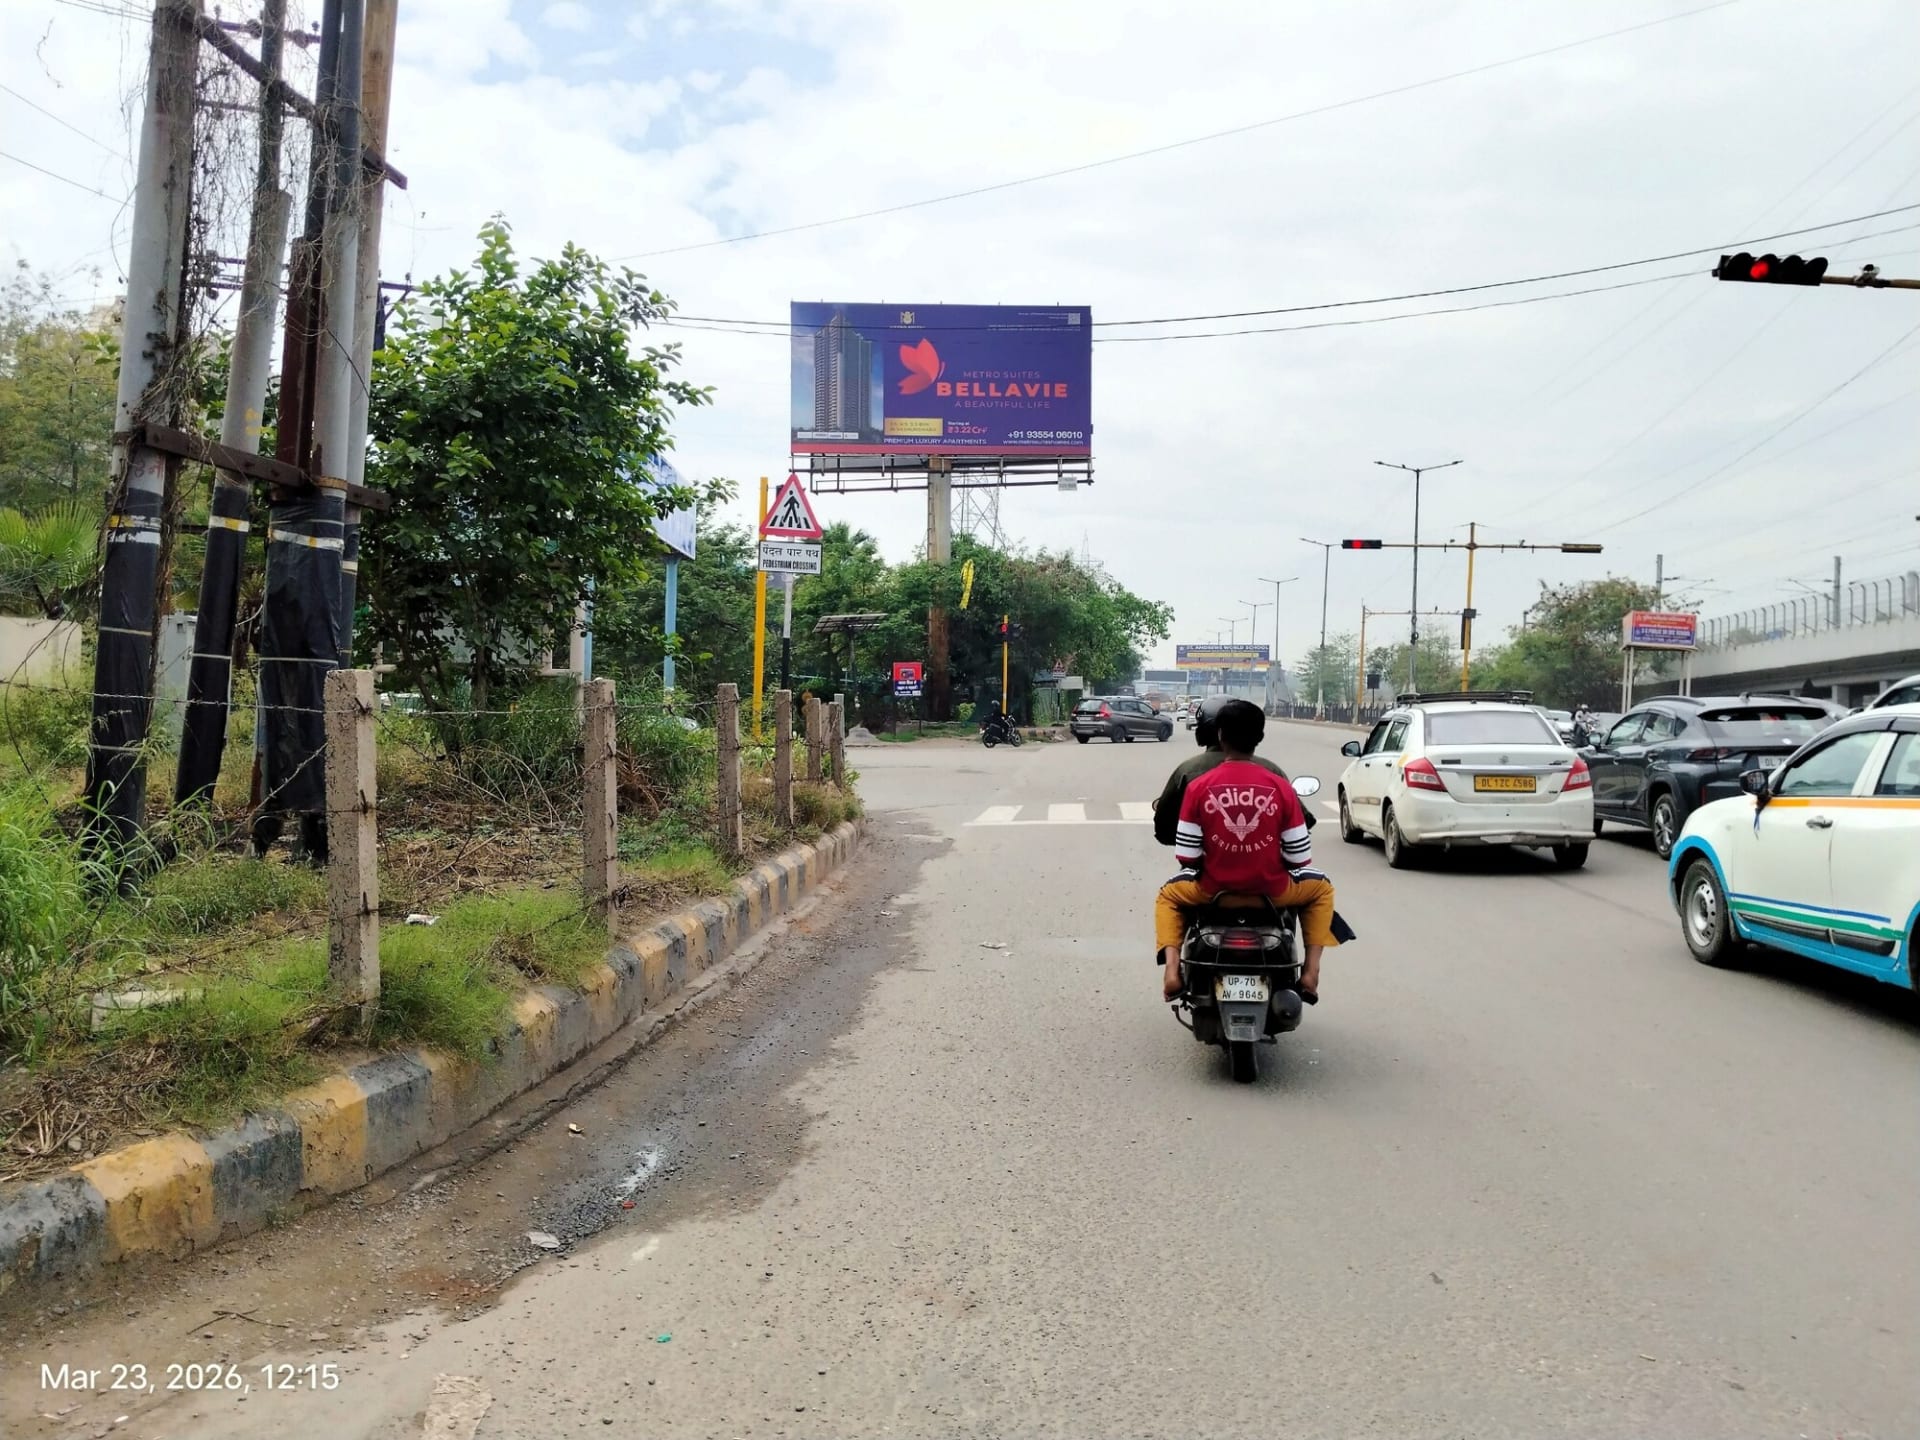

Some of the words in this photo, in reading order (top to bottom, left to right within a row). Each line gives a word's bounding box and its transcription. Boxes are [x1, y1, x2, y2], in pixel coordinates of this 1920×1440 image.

[963, 371, 1001, 379] METRO
[1002, 371, 1040, 379] SUITES
[936, 382, 1068, 398] BELLAVIE
[954, 400, 962, 408] A
[964, 400, 1024, 409] BEAUTIFUL
[1027, 401, 1051, 409] LIFE
[1026, 430, 1054, 439] 93554
[1056, 430, 1083, 439] 06010
[762, 559, 792, 569] PEDESTRIAN
[792, 560, 817, 571] CROSSING
[1204, 787, 1278, 817] adidas
[1211, 834, 1274, 853] ORIGINALS
